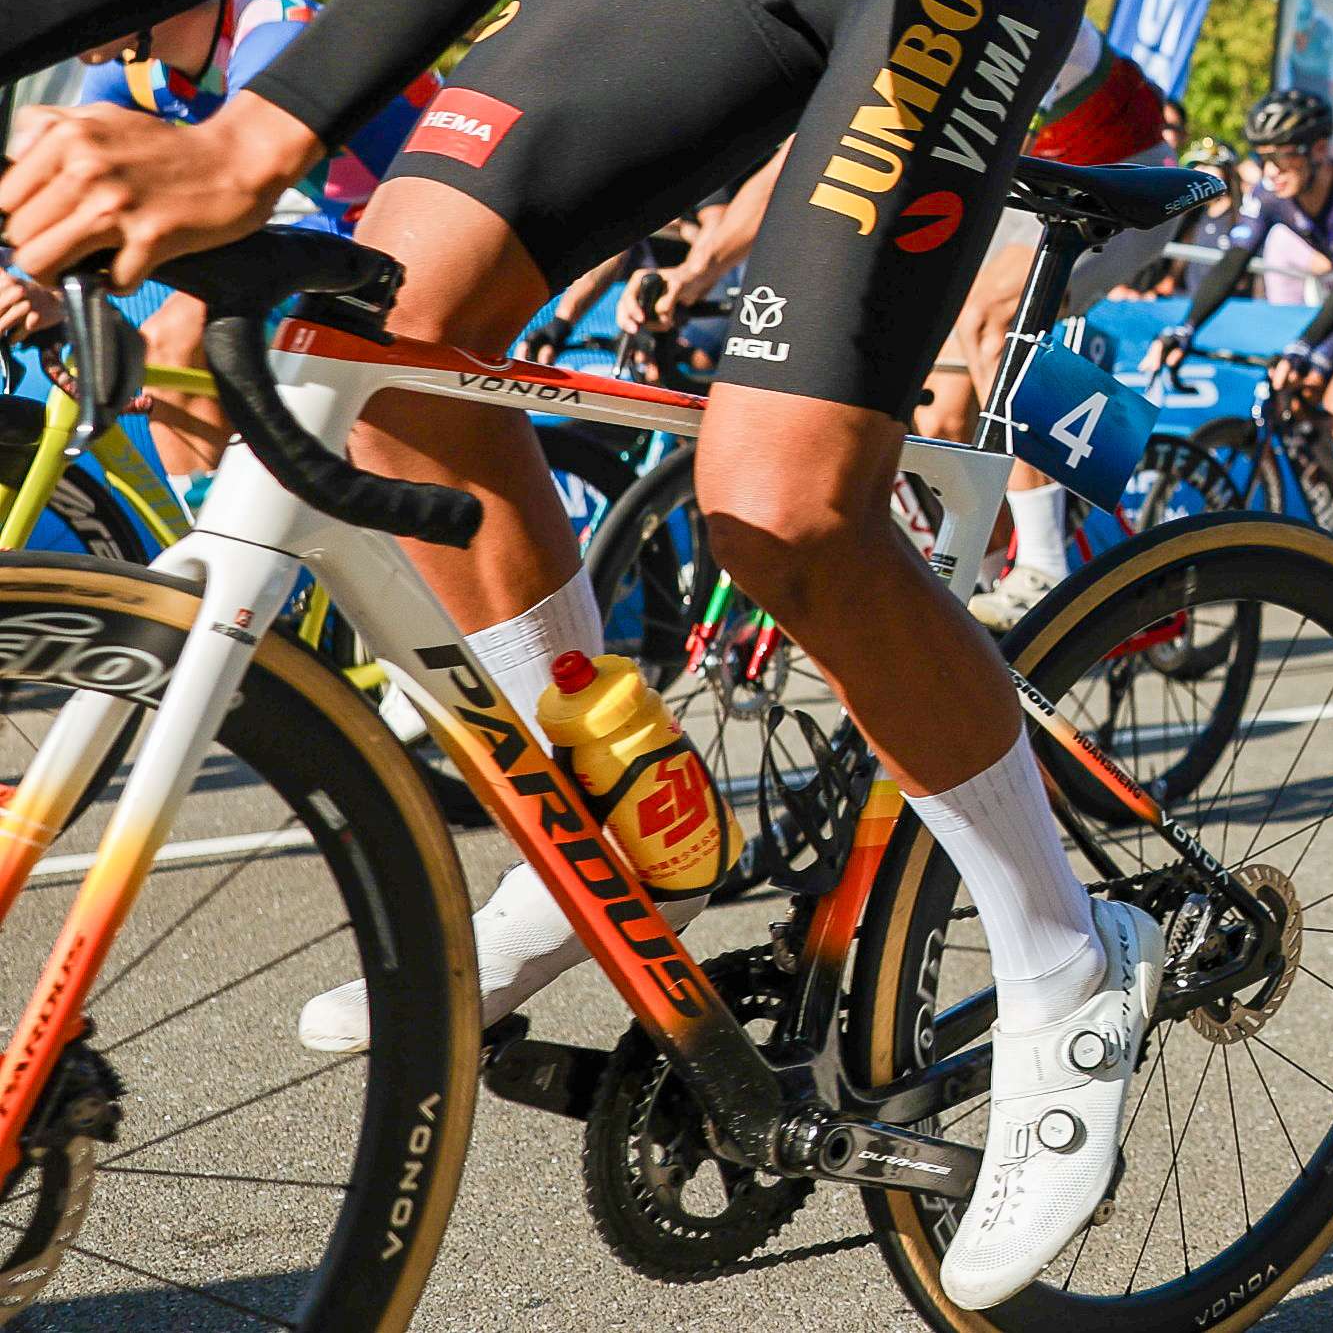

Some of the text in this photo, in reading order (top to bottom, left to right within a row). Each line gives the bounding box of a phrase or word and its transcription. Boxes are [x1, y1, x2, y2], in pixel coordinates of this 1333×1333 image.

[420, 110, 492, 142] HEMA
[930, 14, 1041, 174] VISMA
[724, 336, 791, 362] AGU
[1049, 391, 1109, 469] 4
[413, 643, 701, 1018] PARDUS
